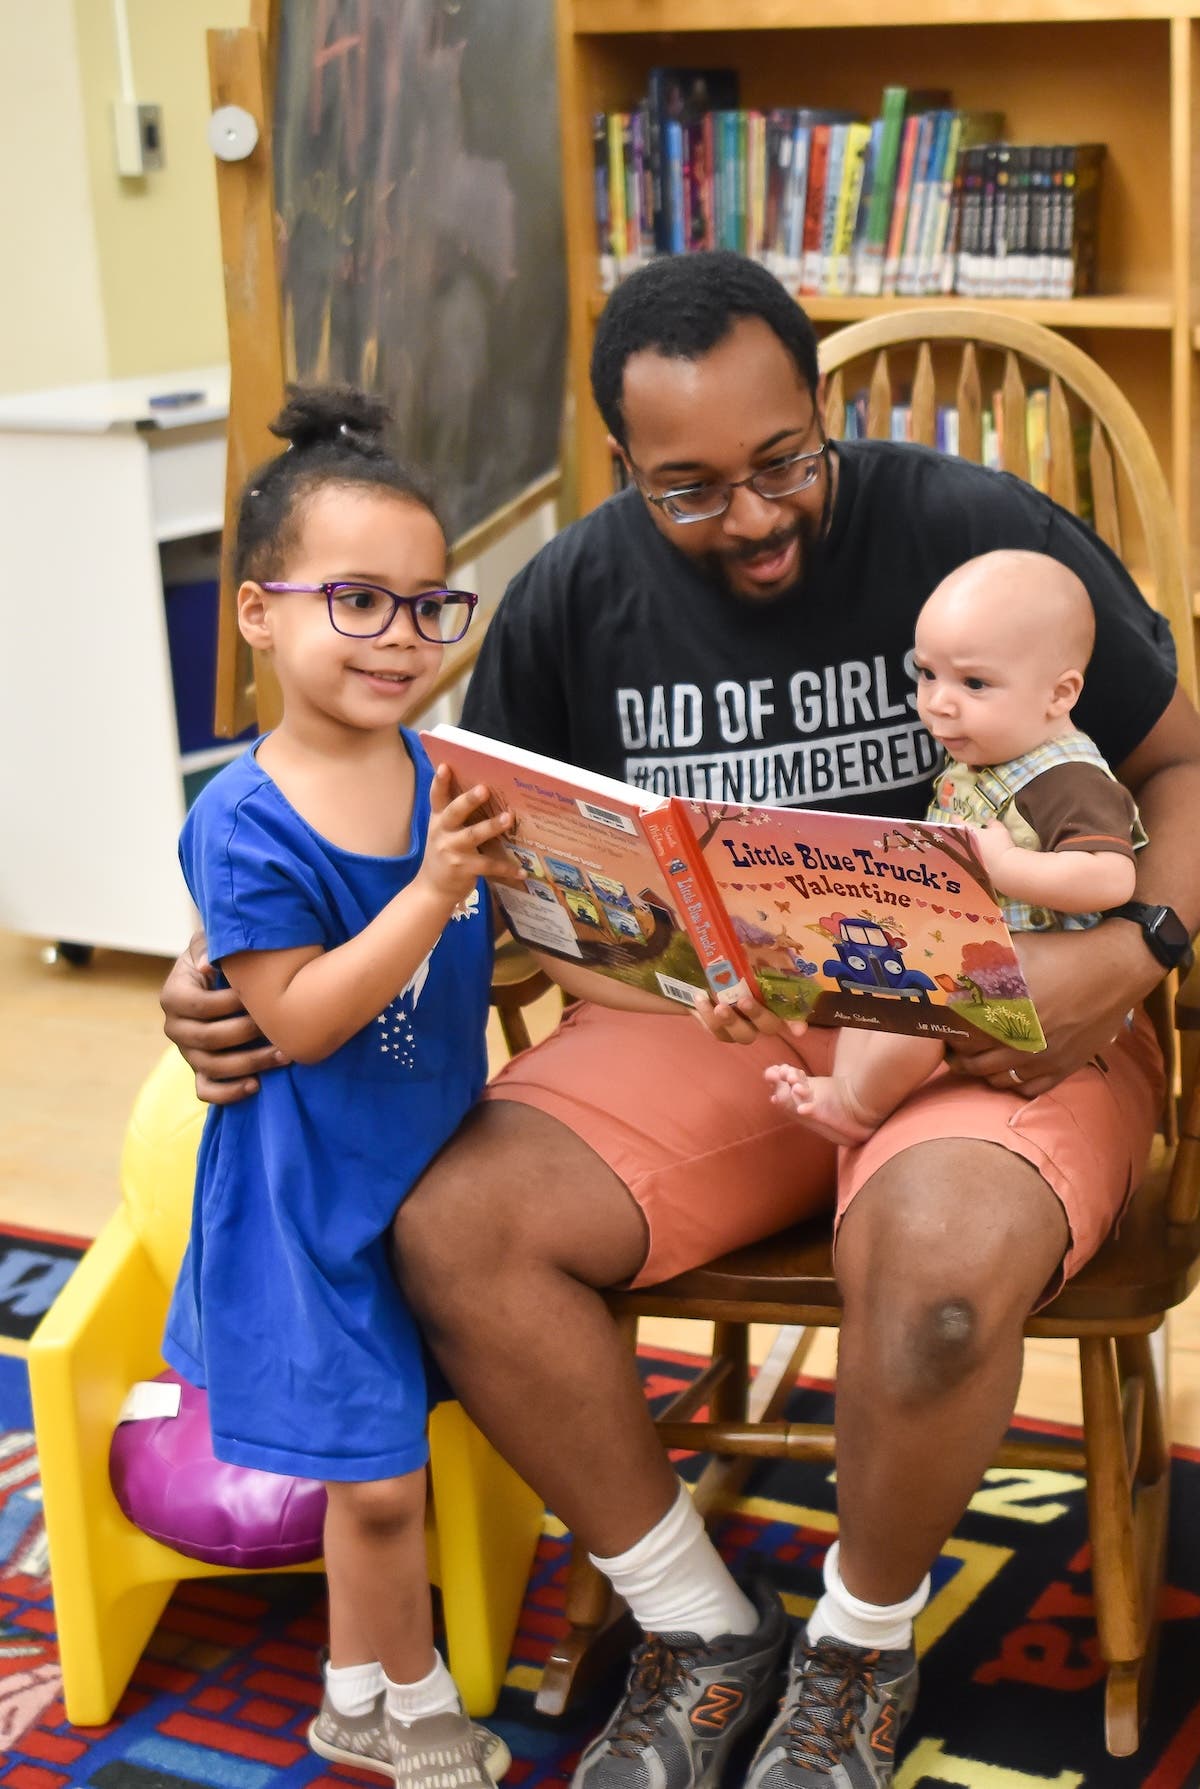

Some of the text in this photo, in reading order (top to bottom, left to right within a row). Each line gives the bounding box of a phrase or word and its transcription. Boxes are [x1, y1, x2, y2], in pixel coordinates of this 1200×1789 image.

[617, 684, 703, 750] DAD
[714, 678, 775, 744] OF
[634, 728, 938, 804] #OUTNUMBERED
[722, 839, 961, 894] Little Blue Truck's
[785, 875, 911, 908] Valentine
